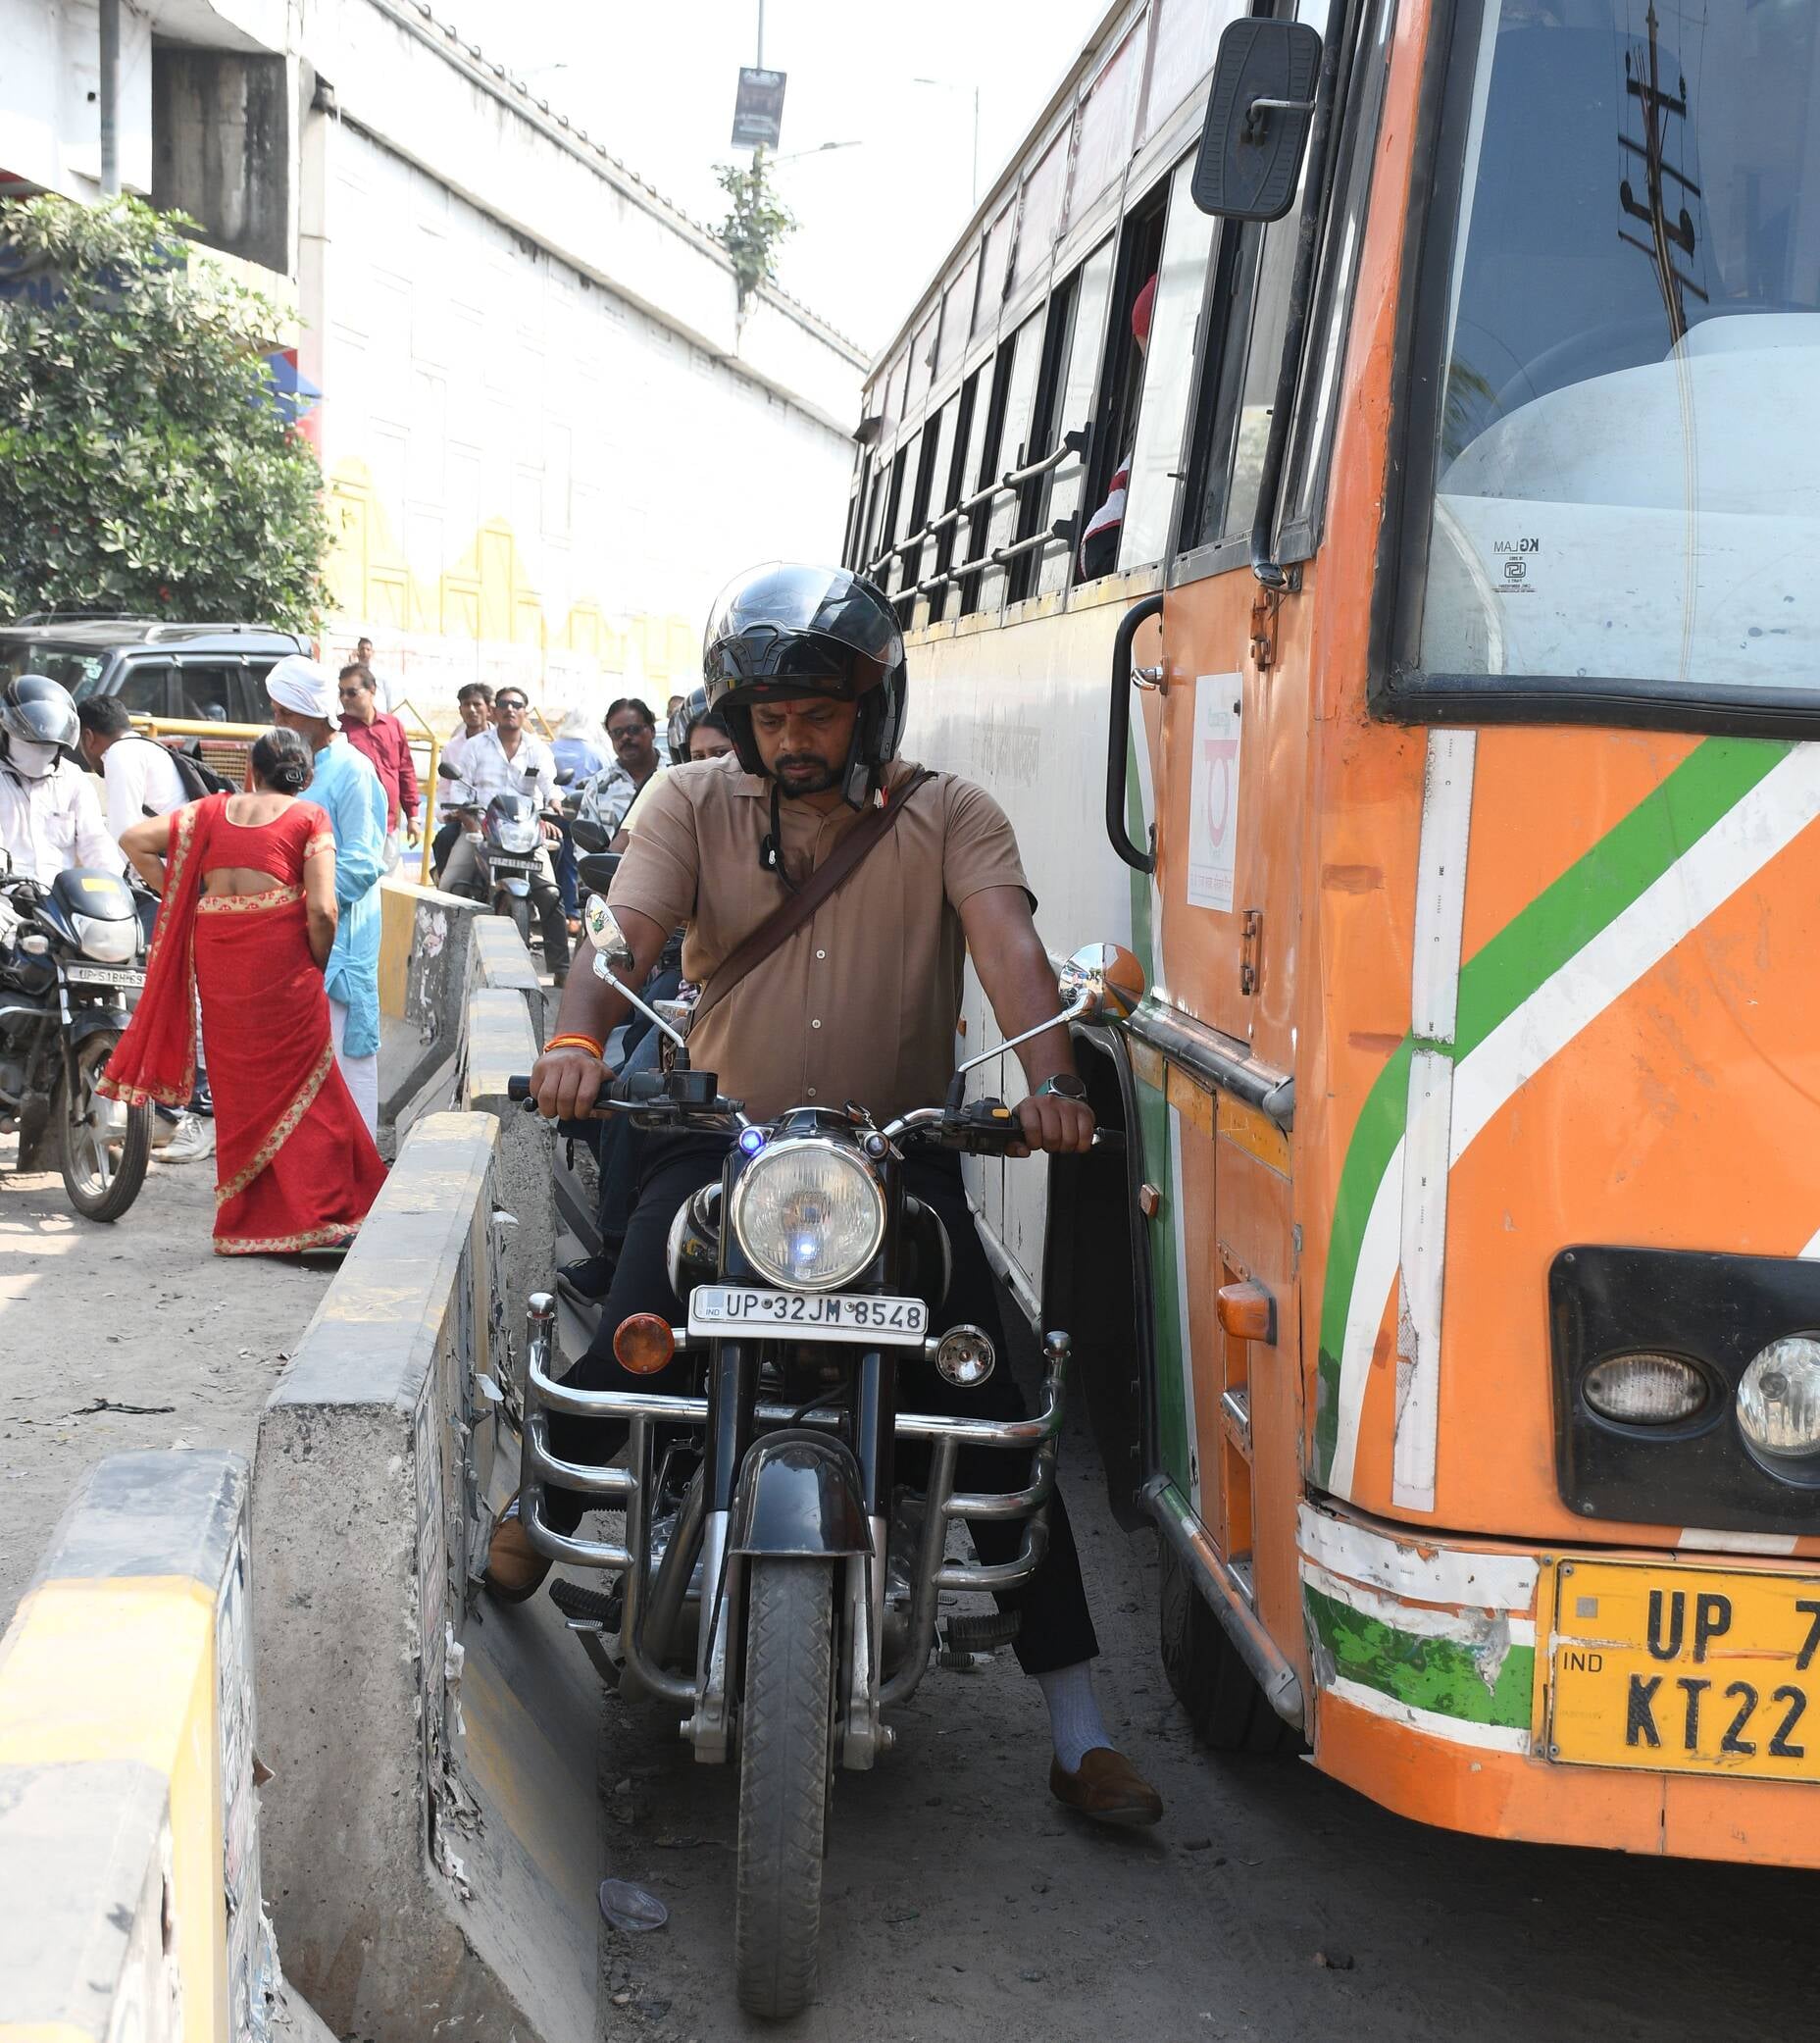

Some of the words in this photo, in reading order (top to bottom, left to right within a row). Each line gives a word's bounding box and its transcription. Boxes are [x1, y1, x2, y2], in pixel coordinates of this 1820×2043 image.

[727, 1294, 759, 1317] UP
[773, 1296, 841, 1323] 32JM
[854, 1301, 922, 1329] 8548
[1646, 1589, 1732, 1663] UP
[1563, 1652, 1603, 1673] IND
[1626, 1672, 1807, 1758] KT22
